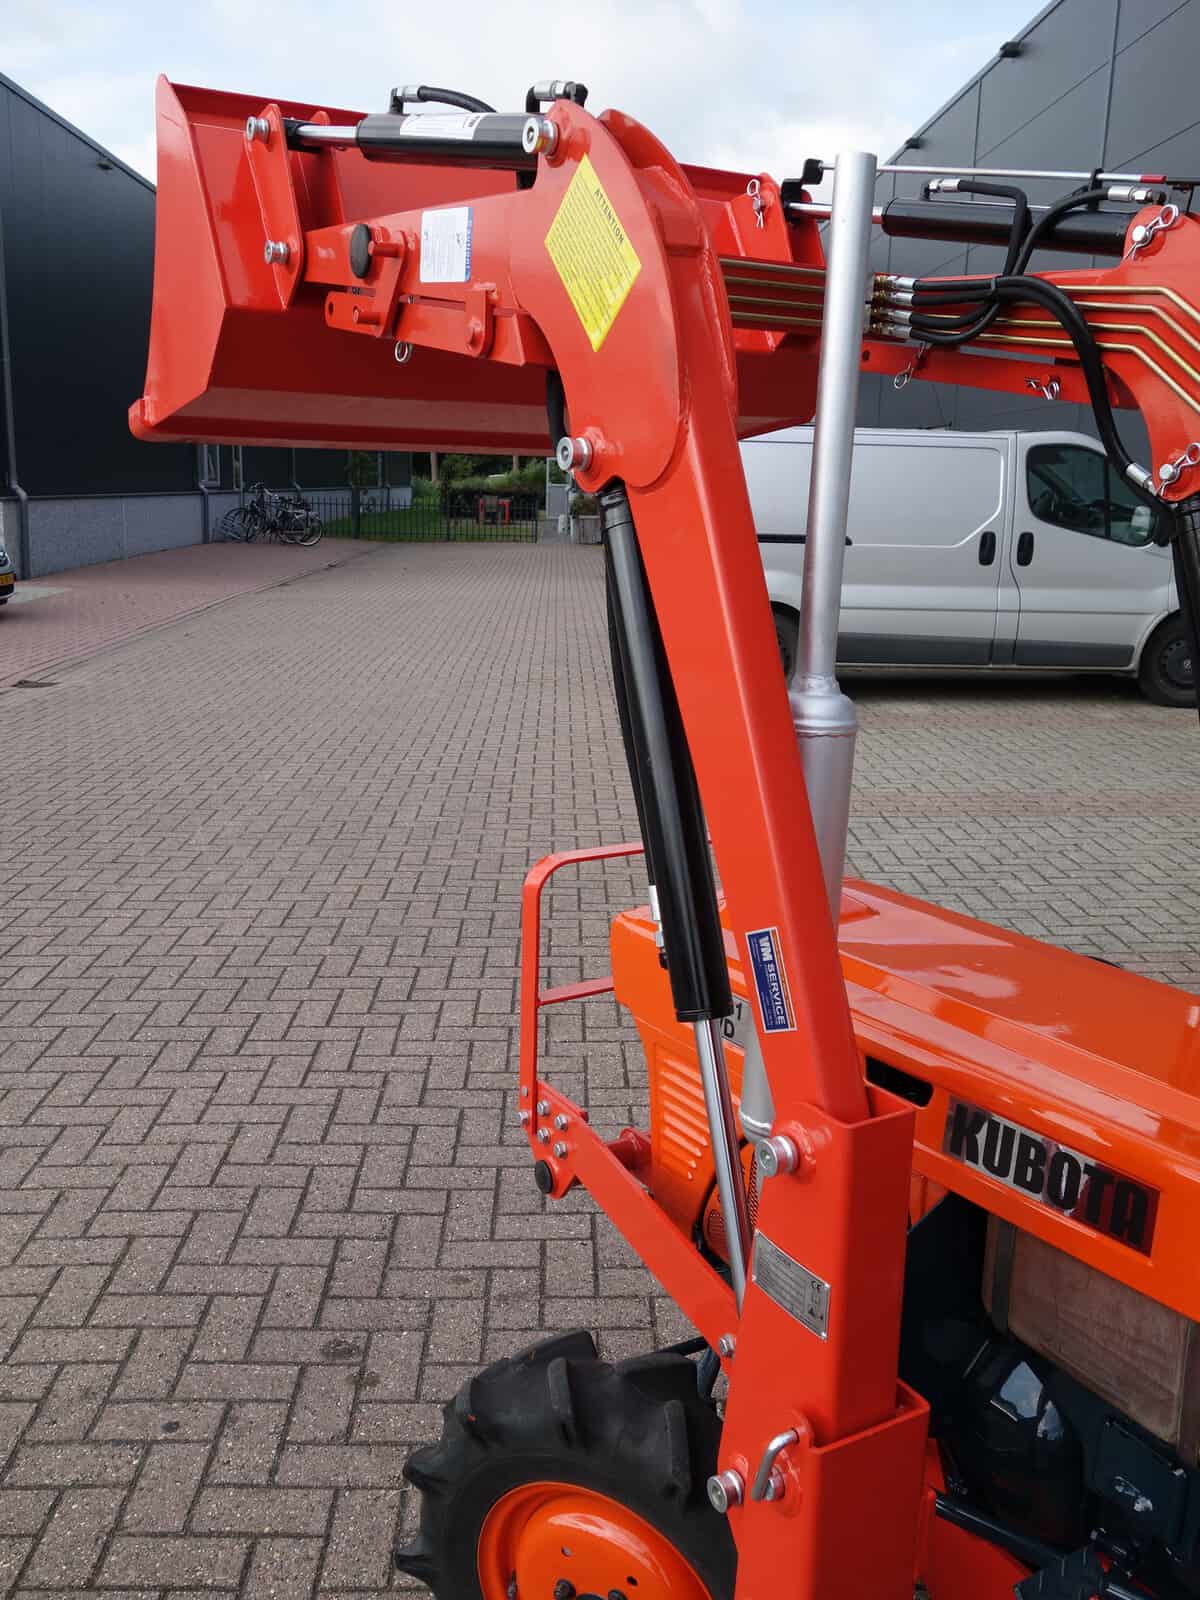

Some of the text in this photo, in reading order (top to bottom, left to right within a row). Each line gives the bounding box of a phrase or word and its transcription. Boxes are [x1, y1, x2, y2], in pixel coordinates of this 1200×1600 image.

[593, 188, 624, 244] ATTENTION
[767, 963, 786, 1025] SERVICE
[951, 1103, 1150, 1248] KUBOTA
